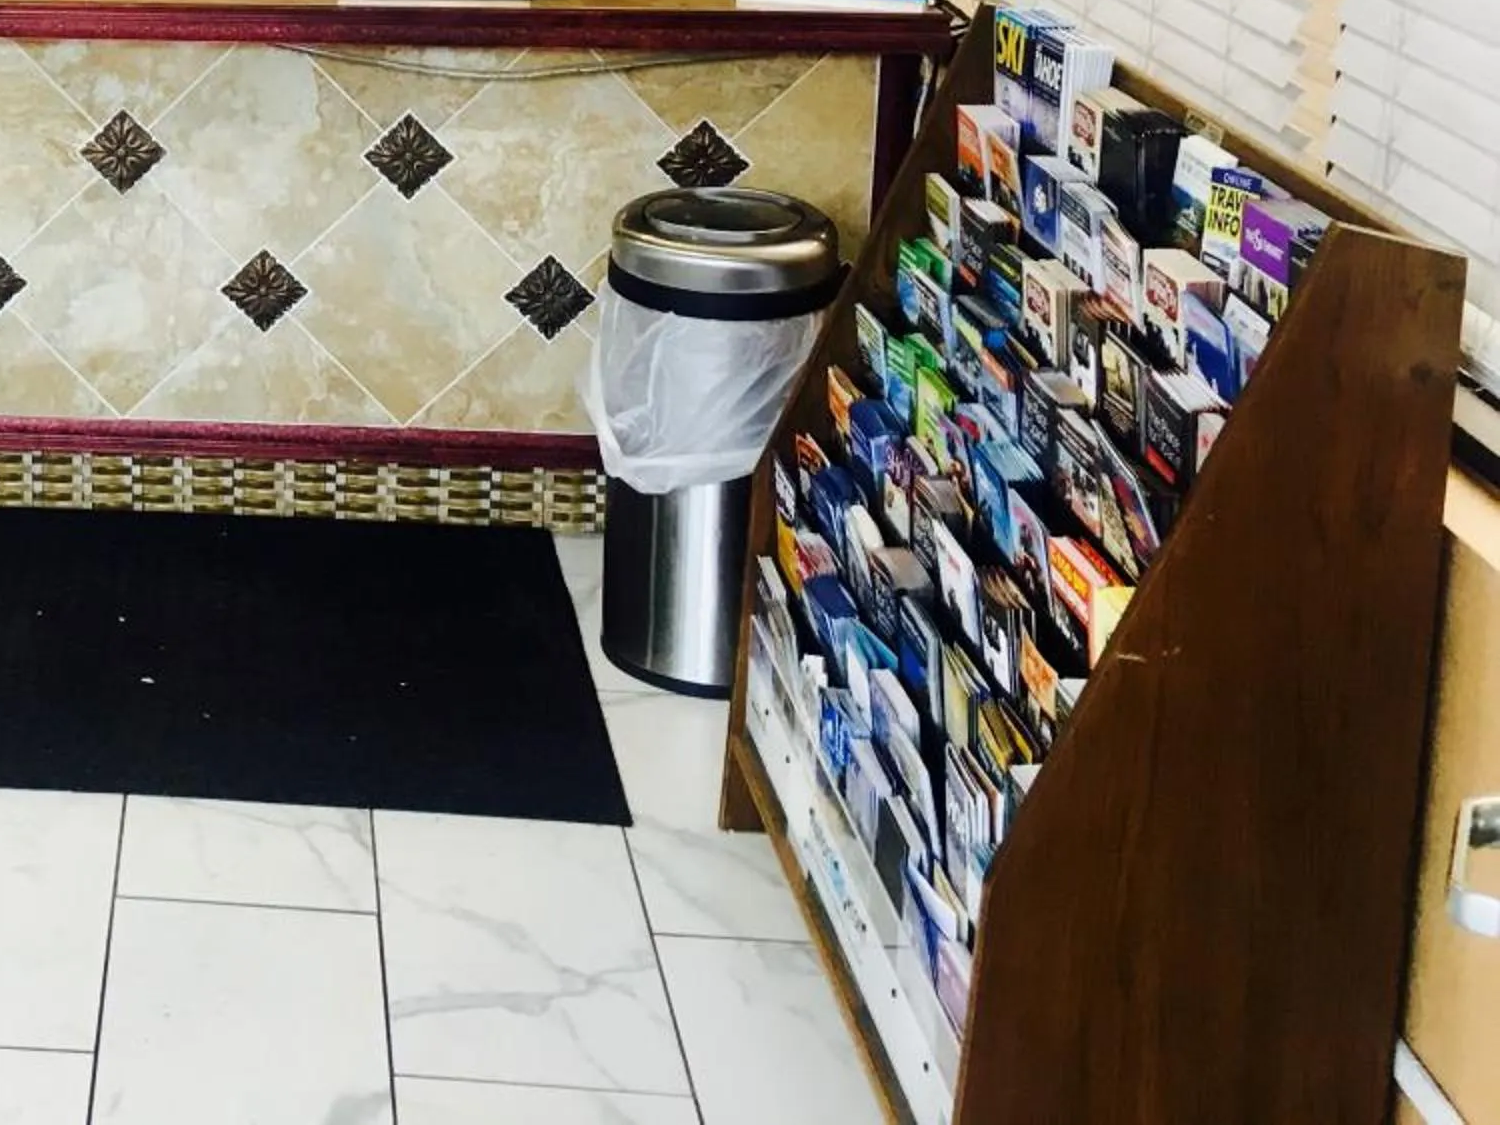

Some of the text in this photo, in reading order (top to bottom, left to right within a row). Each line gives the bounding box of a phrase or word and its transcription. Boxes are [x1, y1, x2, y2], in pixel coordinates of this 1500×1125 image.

[996, 18, 1025, 76] SKI
[1210, 185, 1248, 212] TRAV
[1207, 206, 1241, 236] INFO
